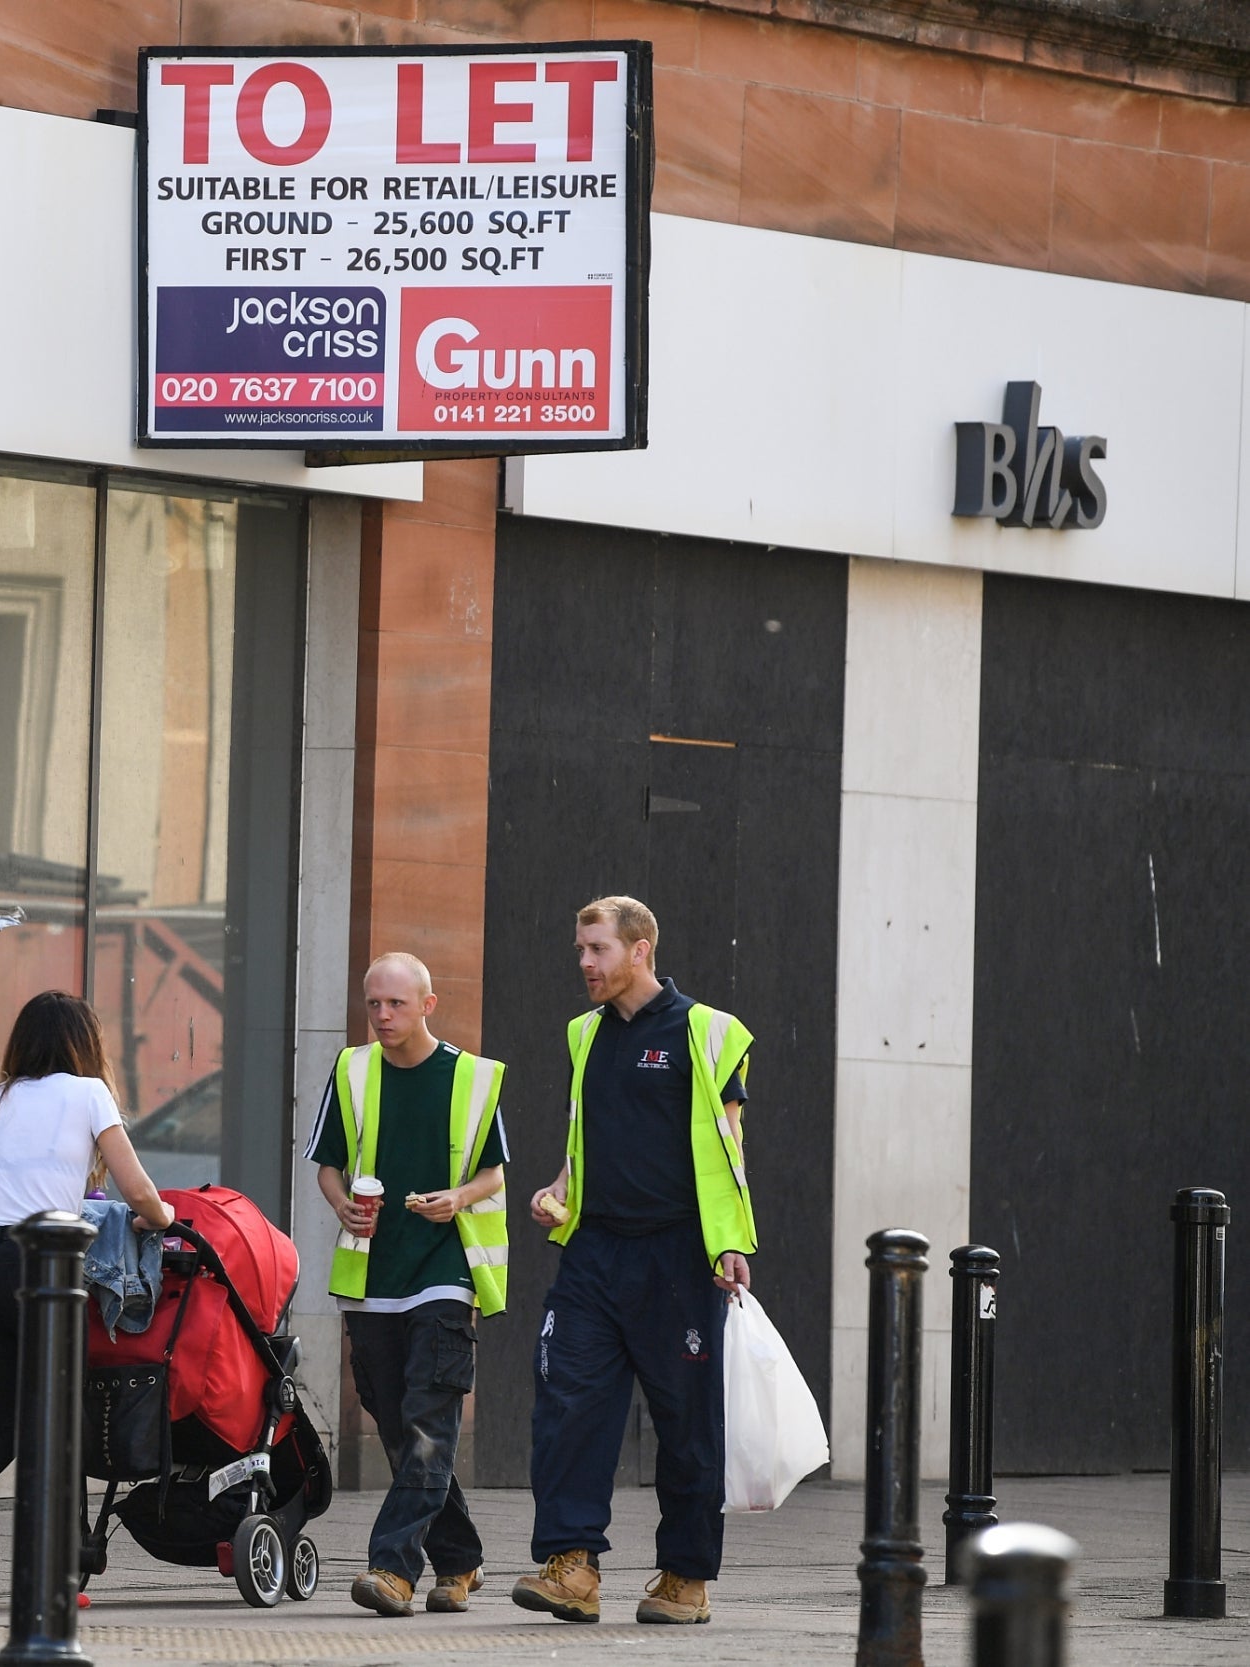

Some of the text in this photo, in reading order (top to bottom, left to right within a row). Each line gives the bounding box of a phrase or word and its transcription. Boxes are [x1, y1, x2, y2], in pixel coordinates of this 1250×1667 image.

[161, 60, 618, 166] TO LET
[157, 174, 617, 201] SUITABLE FOR RETAIL/LEISURE
[201, 211, 333, 235] GROUND
[373, 210, 474, 238] 25,600
[488, 210, 571, 239] SQ.FT
[225, 247, 307, 271] FIRST
[347, 247, 447, 275] 26,500
[461, 246, 545, 275] SQ.FT
[226, 291, 379, 334] jackson
[283, 329, 378, 358] criss
[415, 317, 596, 389] Gunn
[161, 377, 377, 402] 020 7637 7100
[435, 391, 595, 401] PROPERTY CONSULTANTS
[224, 411, 373, 426] www.jacksoncriss.co.uk
[434, 404, 596, 422] 0141 221 3500
